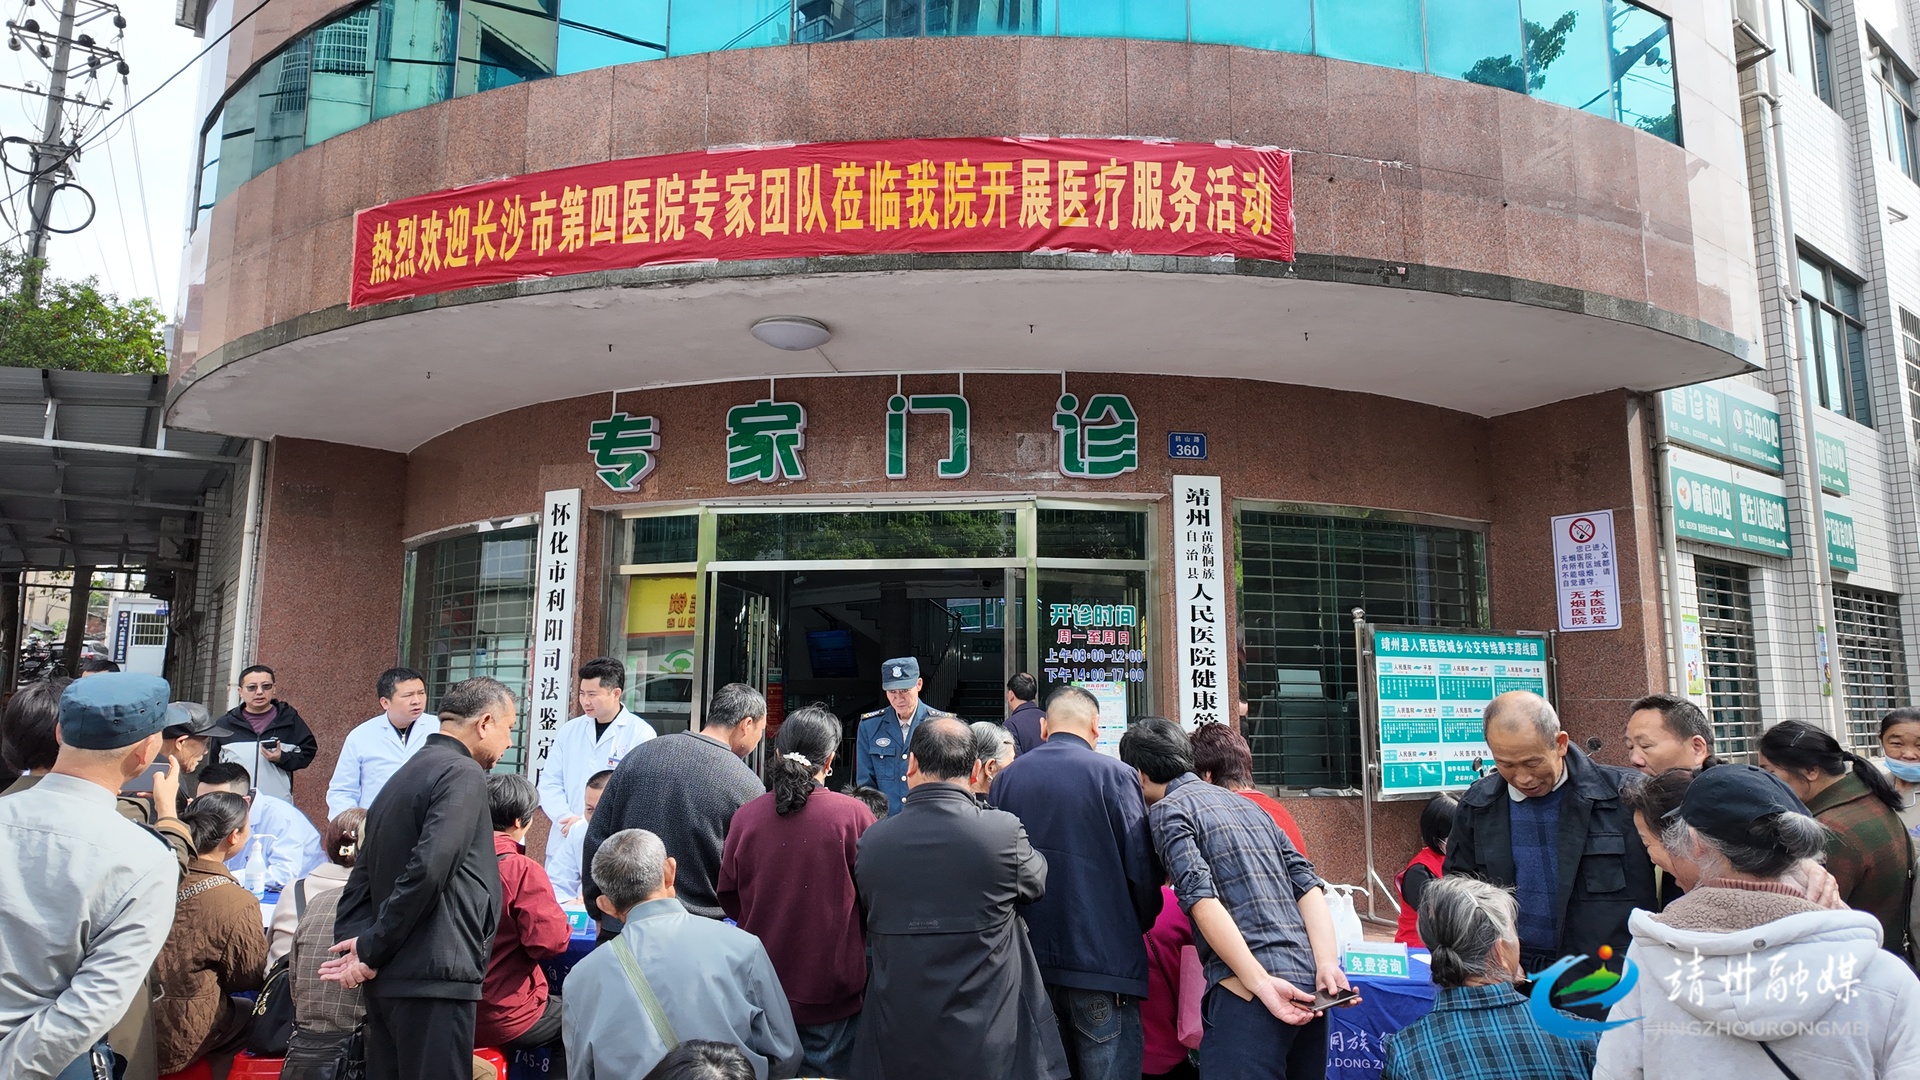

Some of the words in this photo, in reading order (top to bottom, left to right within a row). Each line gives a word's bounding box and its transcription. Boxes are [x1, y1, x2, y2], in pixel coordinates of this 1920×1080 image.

[370, 157, 1273, 285] 热烈欢迎长沙市第四医院专家团队莅临我院开展医疗服务活动
[588, 391, 1138, 491] 专家门诊
[1176, 445, 1200, 456] 360
[1186, 488, 1211, 527] 靖州
[1186, 530, 1199, 579] 自治县
[1201, 531, 1215, 580] 苗族侗族
[1576, 543, 1609, 553] 您已进入
[1562, 559, 1610, 571] 内所有区域都
[1050, 604, 1137, 627] 开诊时间
[1570, 591, 1588, 626] 无烟医院
[1590, 589, 1607, 624] 本医院是
[1057, 629, 1129, 645] 周一至周日
[1381, 636, 1538, 656] 靖州县人民医院城乡公交专线乘车路线图
[1351, 955, 1402, 975] 免费咨询
[1335, 1058, 1371, 1068] DONG
